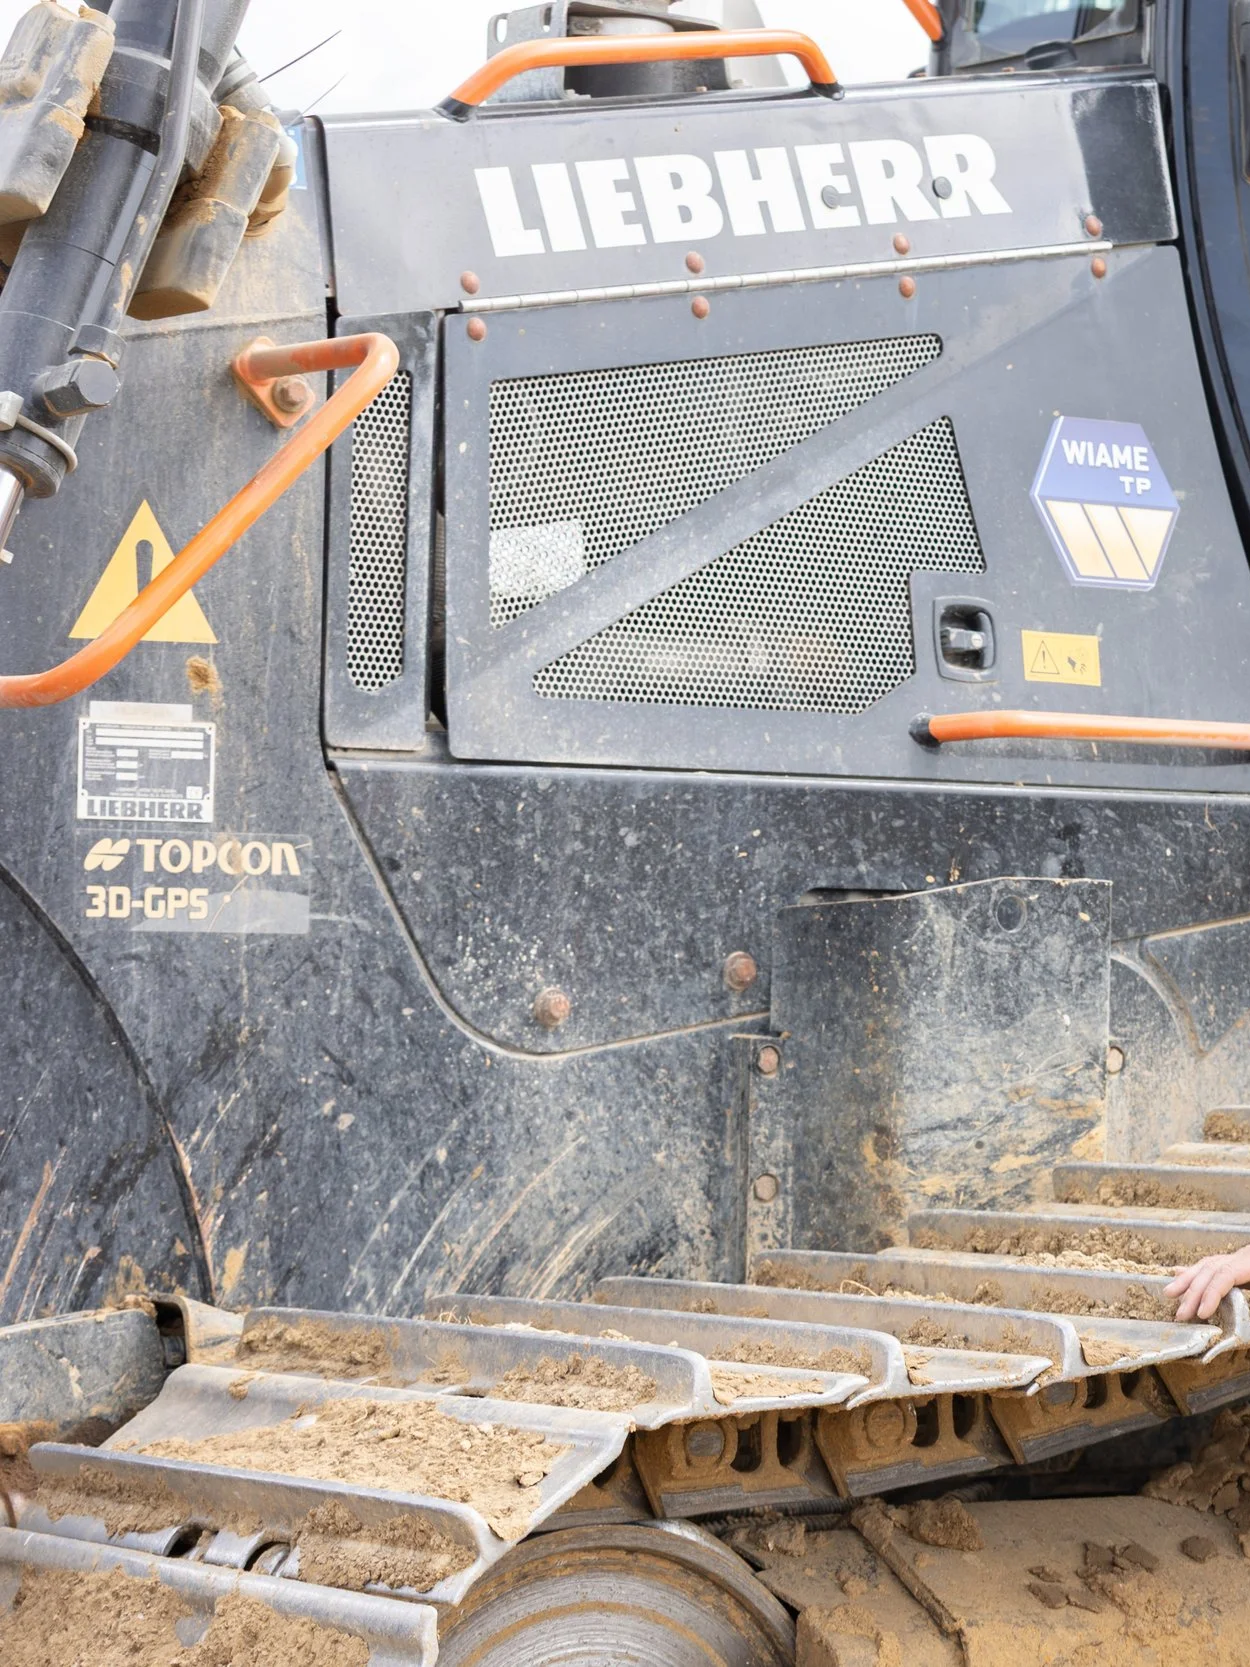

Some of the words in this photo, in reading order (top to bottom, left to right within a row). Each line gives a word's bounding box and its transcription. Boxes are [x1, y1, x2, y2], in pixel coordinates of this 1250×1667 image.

[473, 133, 1013, 257] LIEBHERR
[1061, 438, 1150, 472] WIAME
[1119, 475, 1152, 495] TP
[87, 799, 204, 820] LIEBHERR
[136, 838, 301, 876] TOPCON
[85, 885, 209, 920] 3D-GPS
